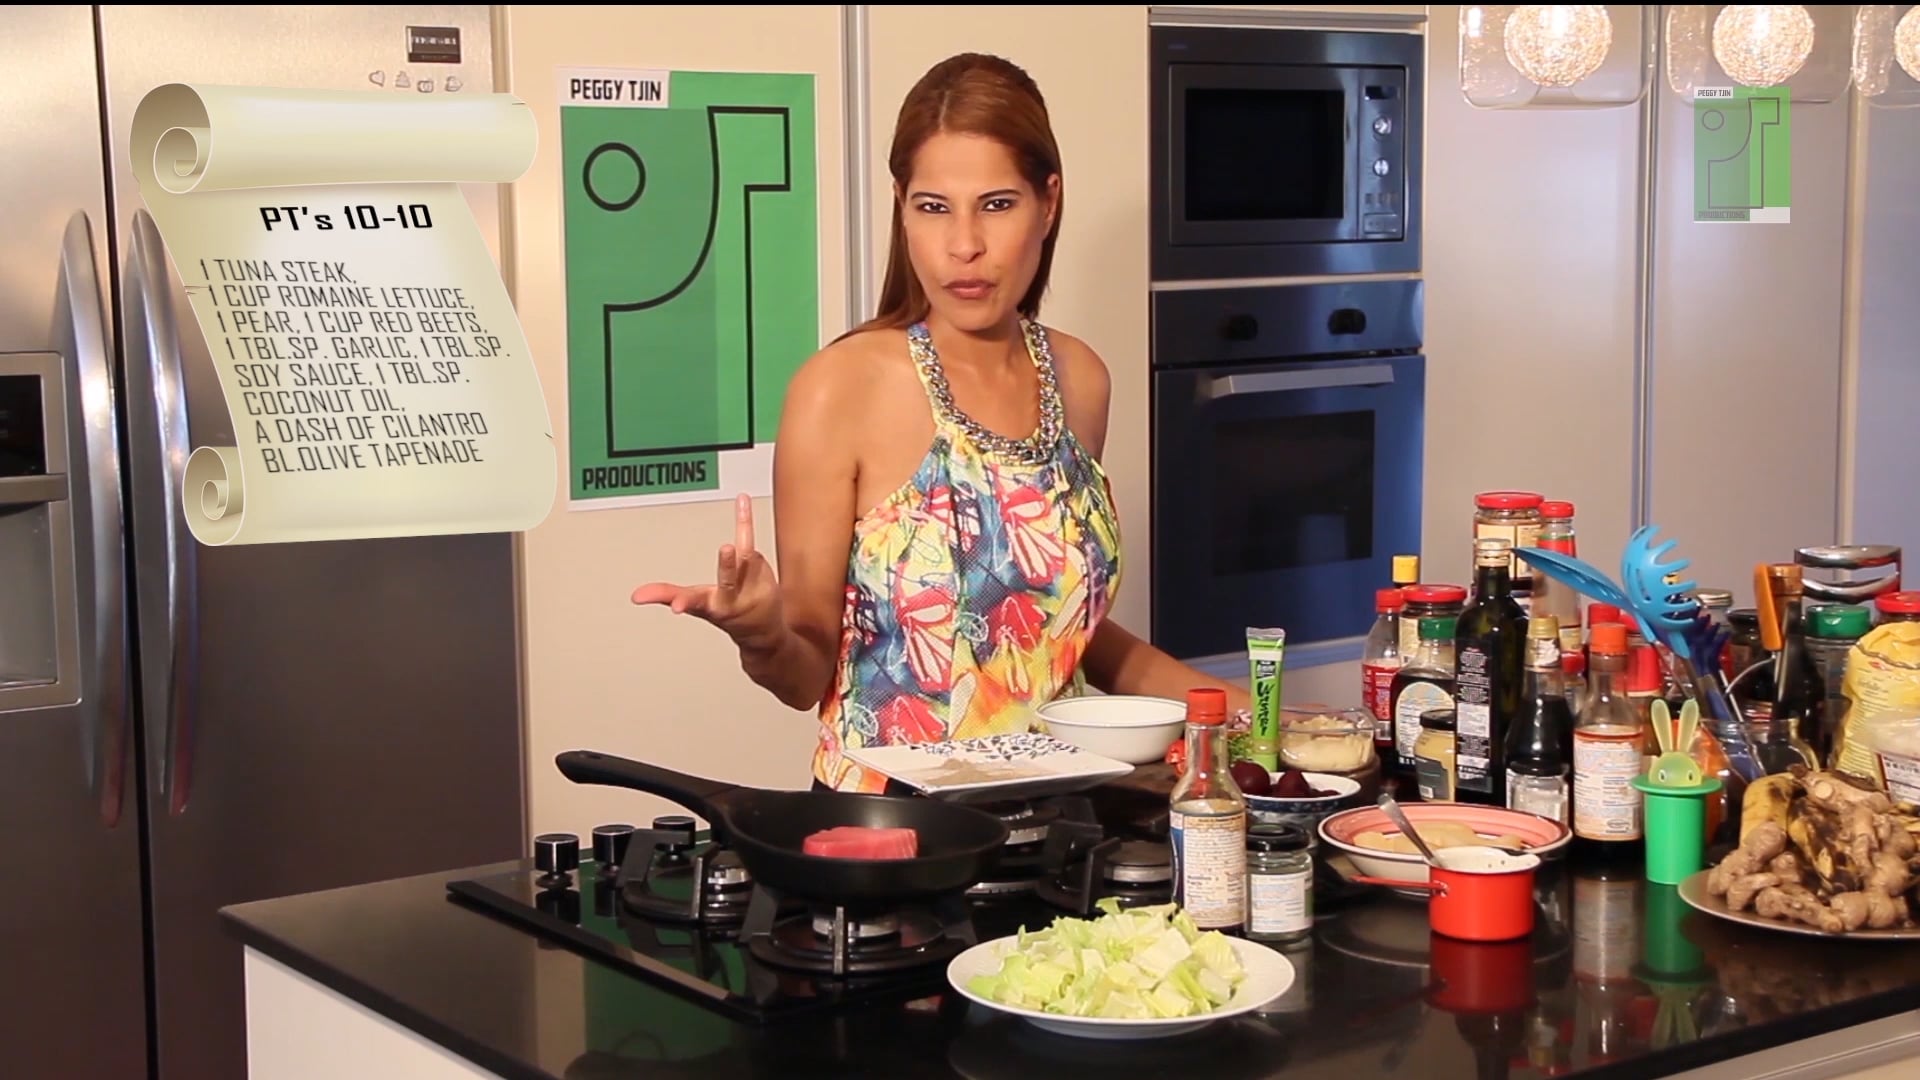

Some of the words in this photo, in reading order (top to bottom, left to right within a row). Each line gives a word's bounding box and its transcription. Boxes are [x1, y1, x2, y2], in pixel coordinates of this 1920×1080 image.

[570, 78, 624, 100] PEGGY
[628, 80, 662, 101] TJIN
[582, 460, 707, 491] PRODUCTIONS
